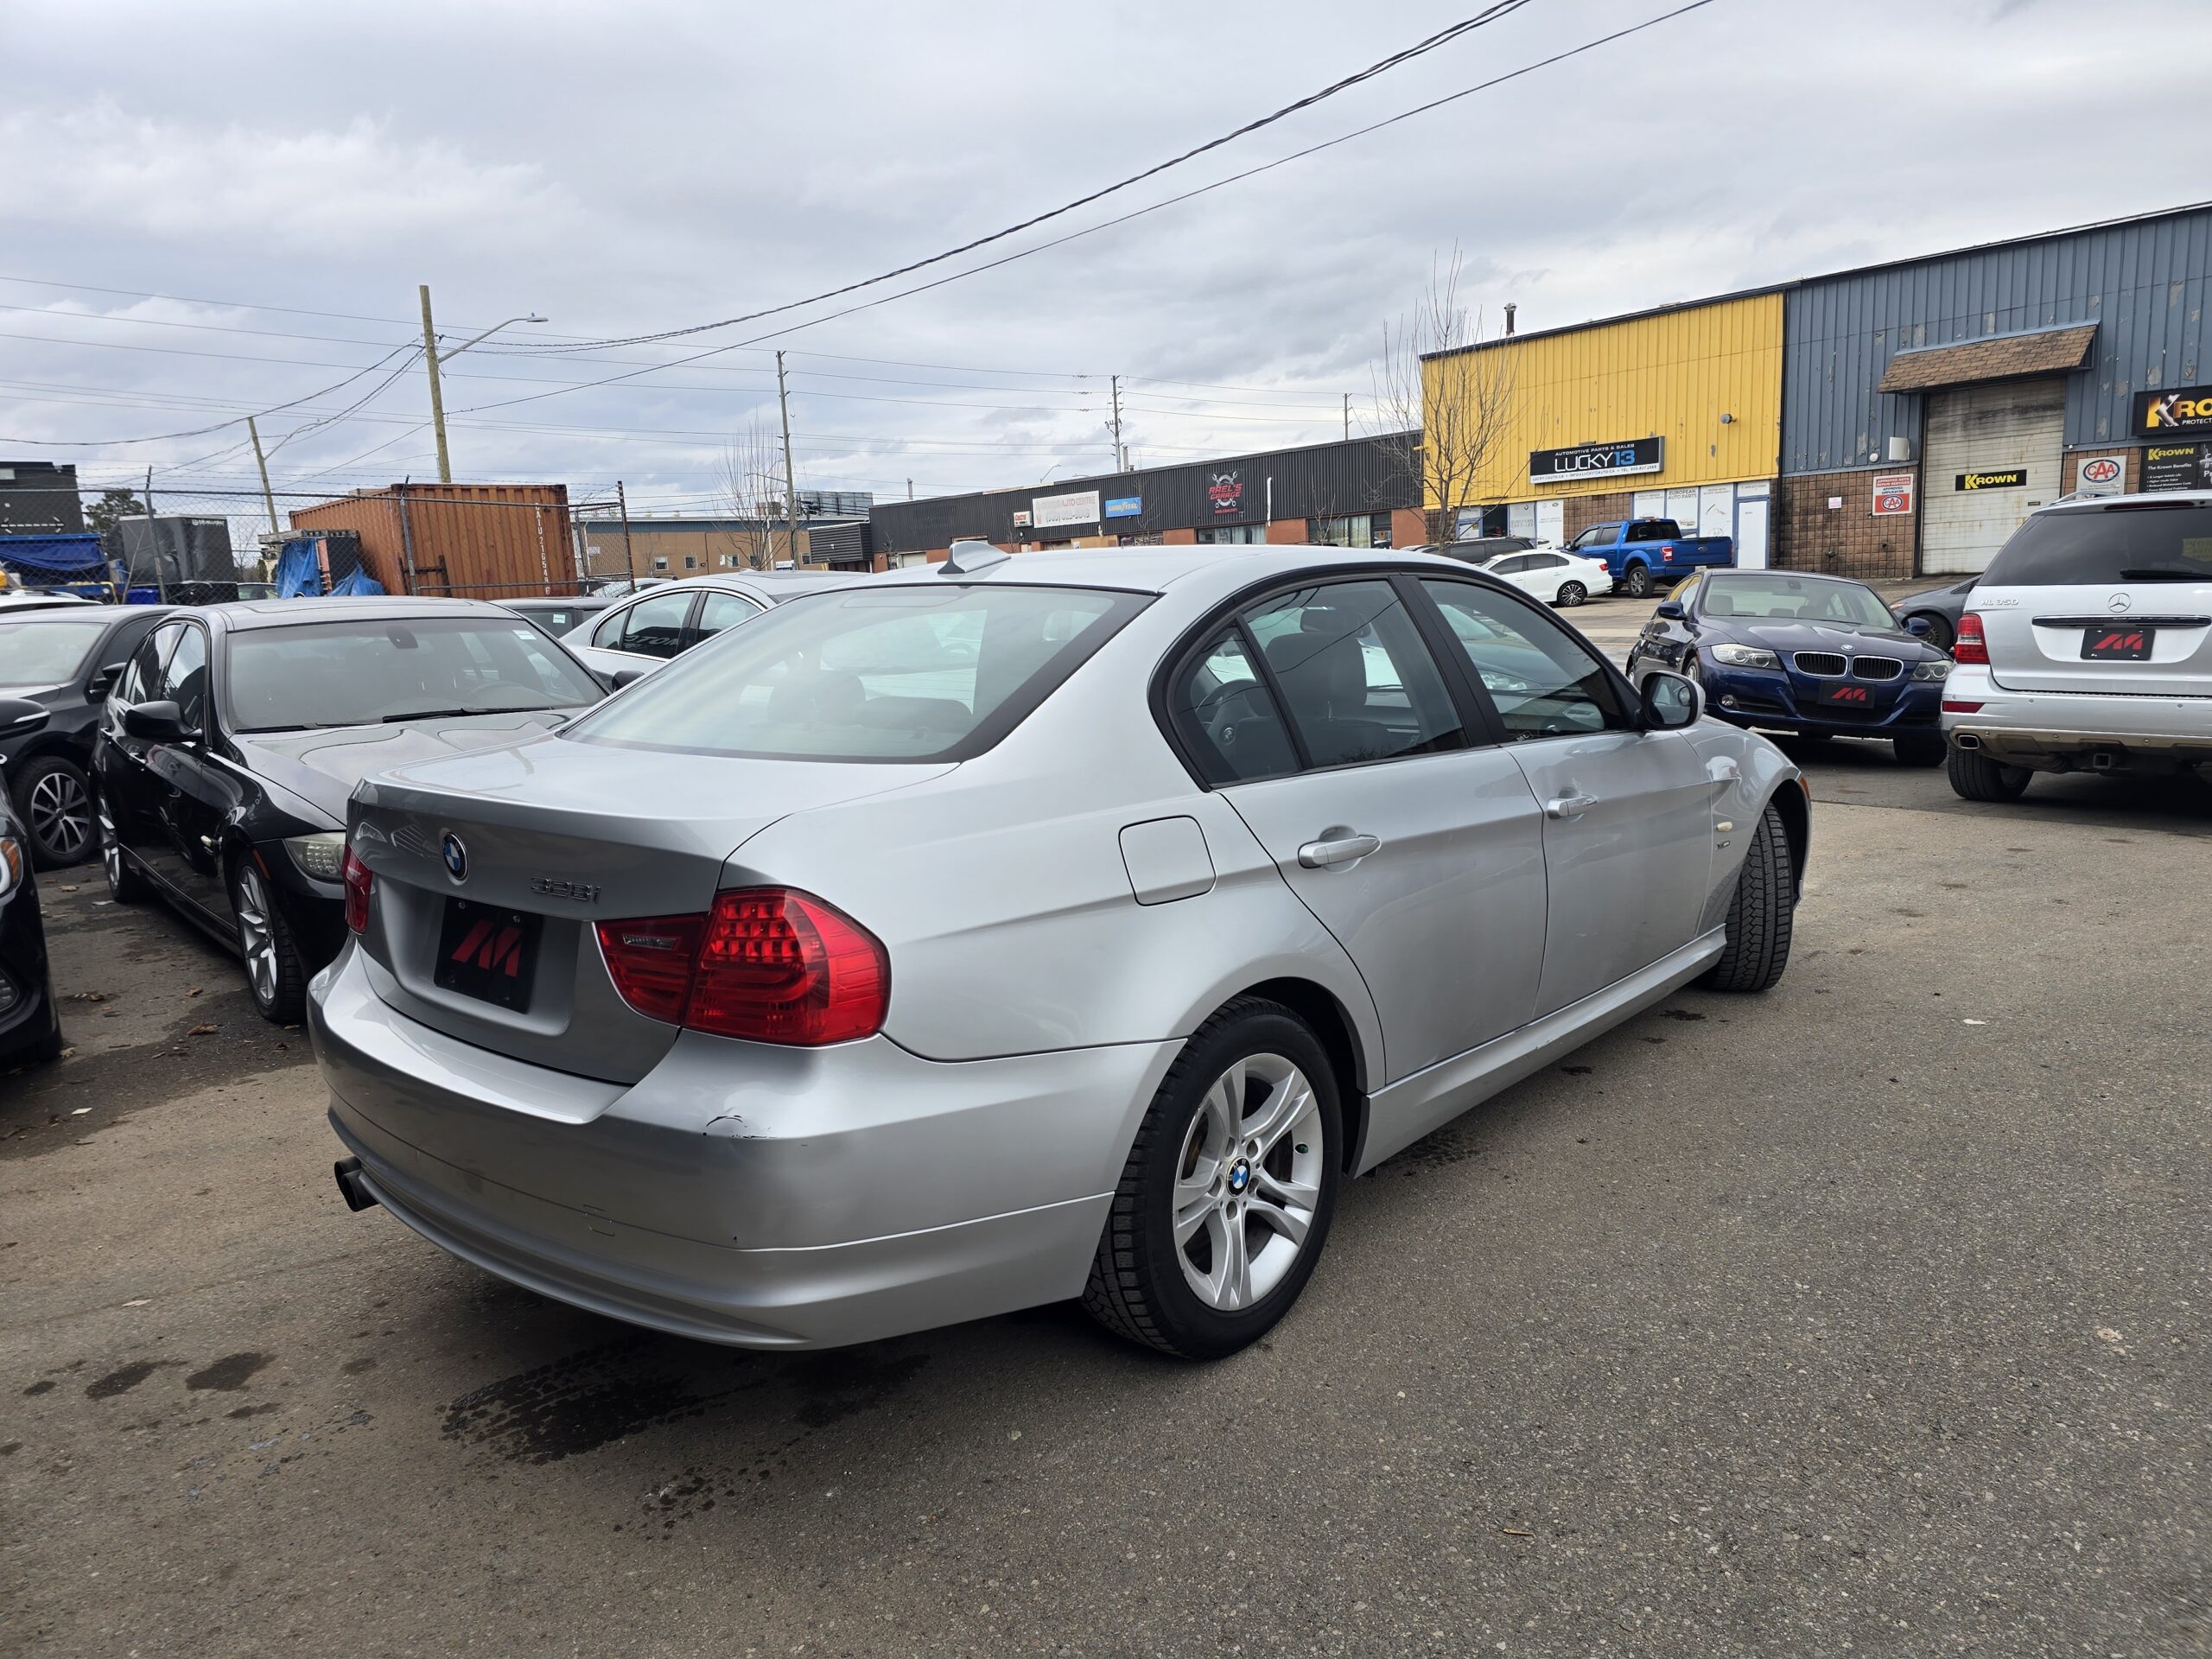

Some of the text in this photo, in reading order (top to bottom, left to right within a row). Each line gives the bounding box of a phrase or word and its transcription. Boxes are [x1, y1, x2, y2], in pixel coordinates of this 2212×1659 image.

[2148, 448, 2195, 461] KROWN
[2088, 461, 2115, 480] CAA
[1964, 474, 2017, 489] KROWN
[1885, 498, 1899, 507] CAA
[531, 876, 601, 905] 328i
